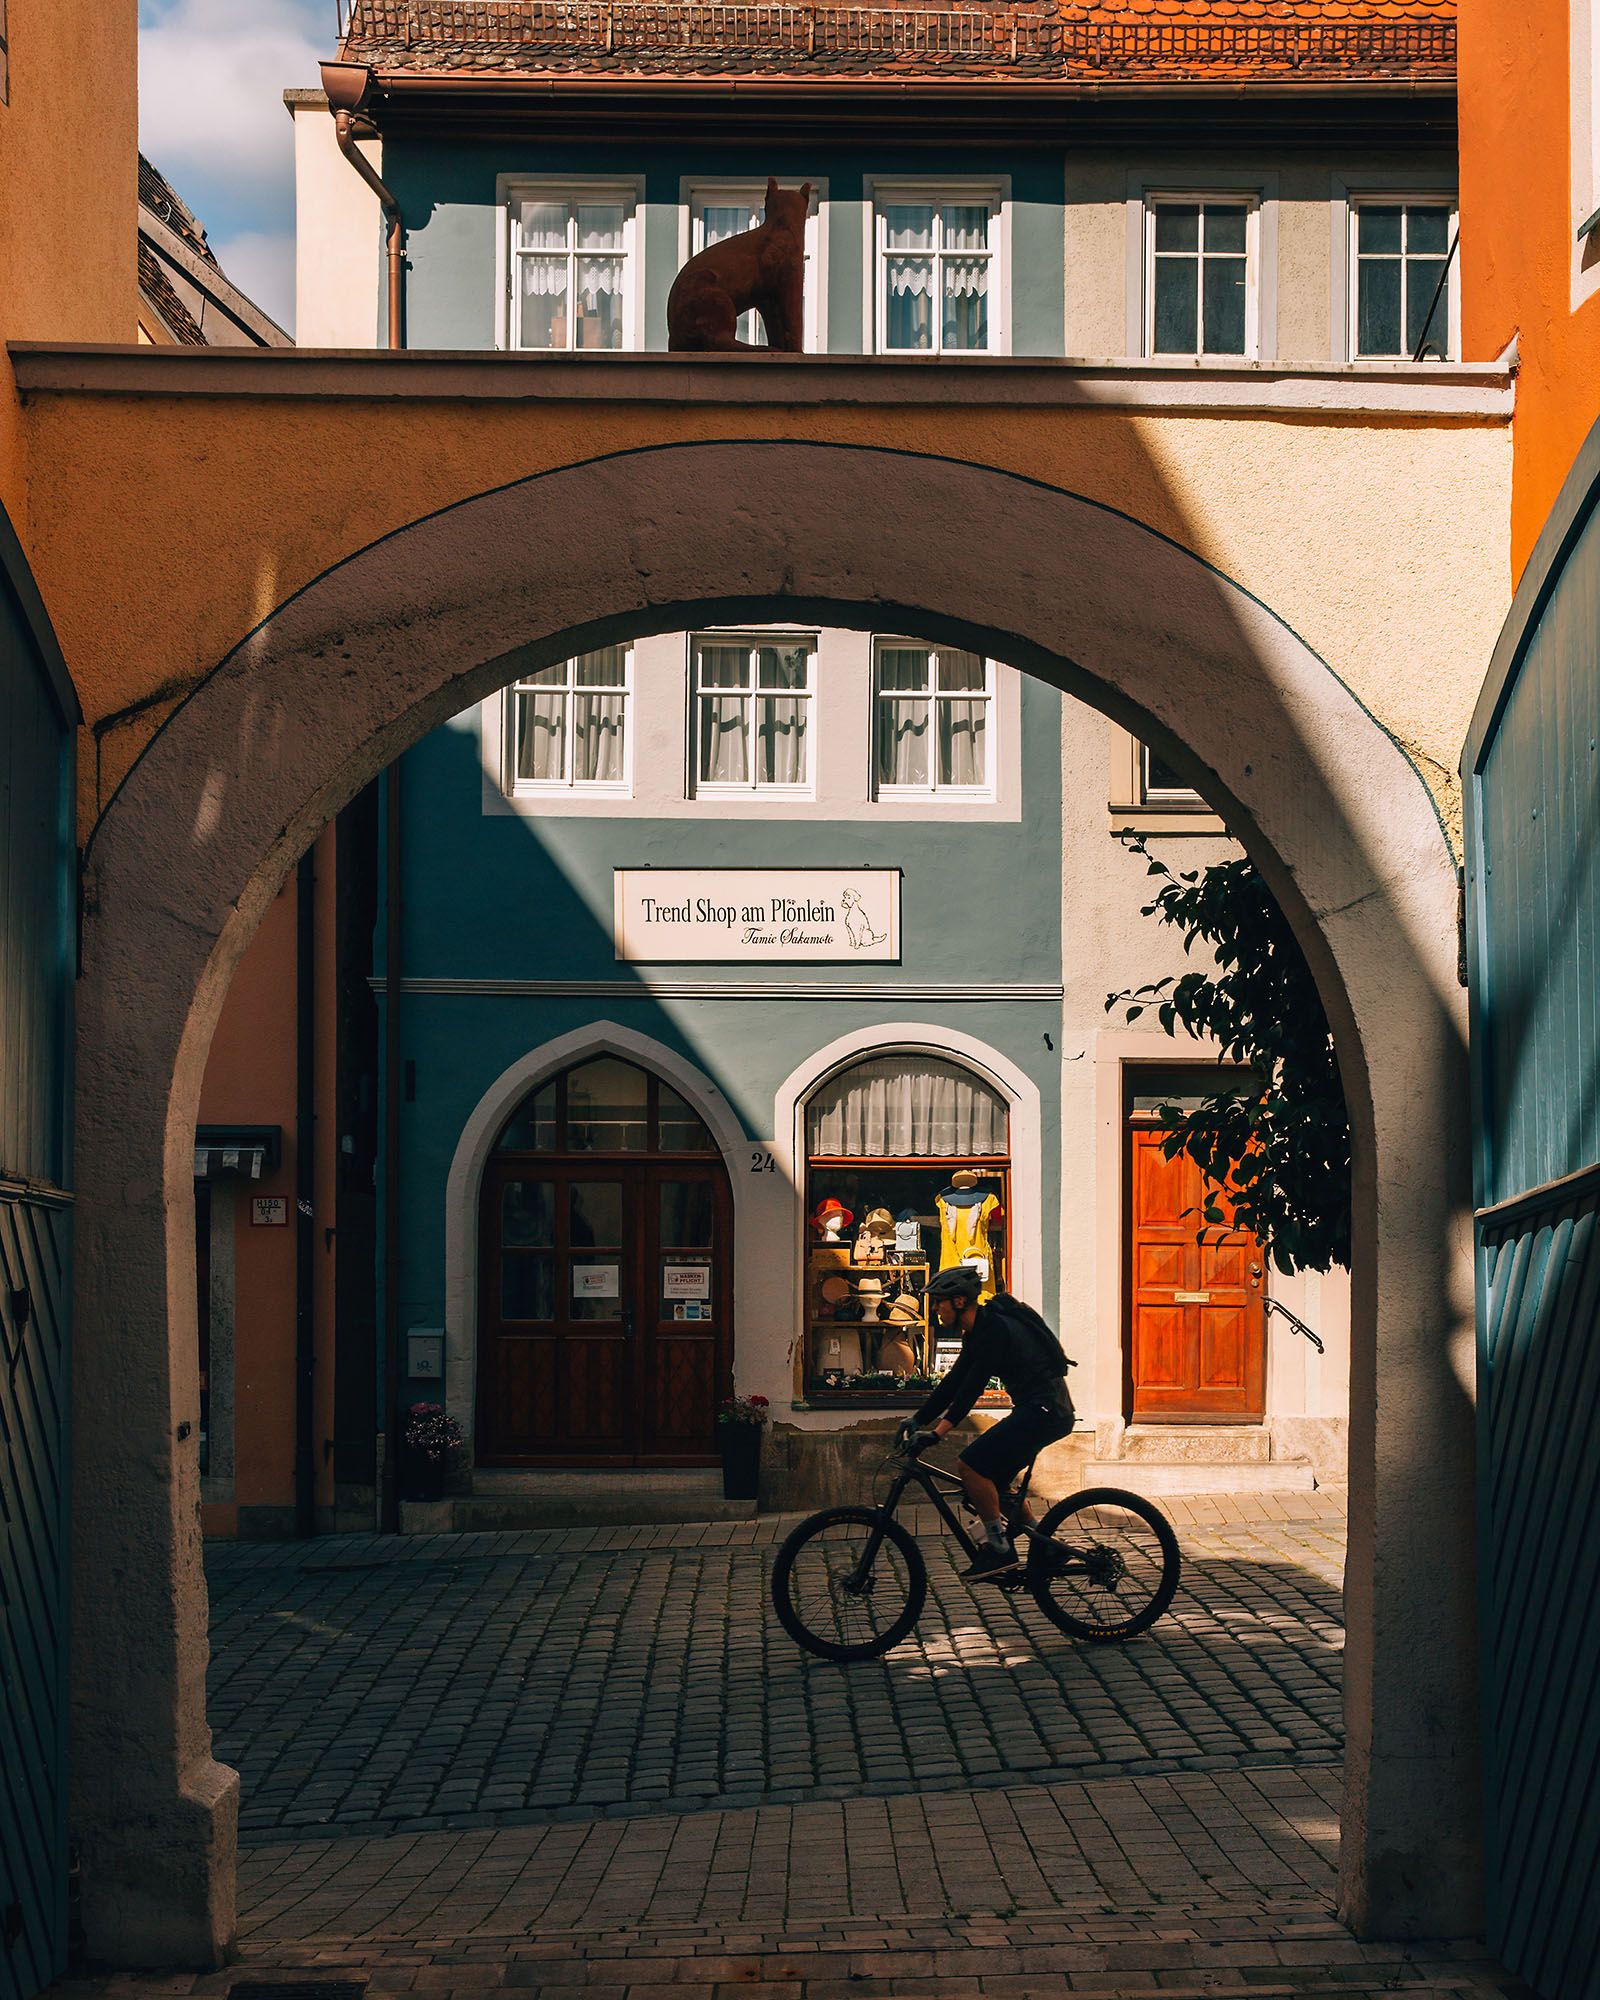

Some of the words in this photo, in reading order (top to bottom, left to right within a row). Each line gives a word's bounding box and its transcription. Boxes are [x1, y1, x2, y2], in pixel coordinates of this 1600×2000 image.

[641, 898, 692, 923] Trend
[695, 898, 737, 928] Shop
[741, 905, 766, 923] am
[770, 898, 835, 923] Plönlein
[779, 926, 834, 948] Sakamoto
[750, 1152, 777, 1173] 24
